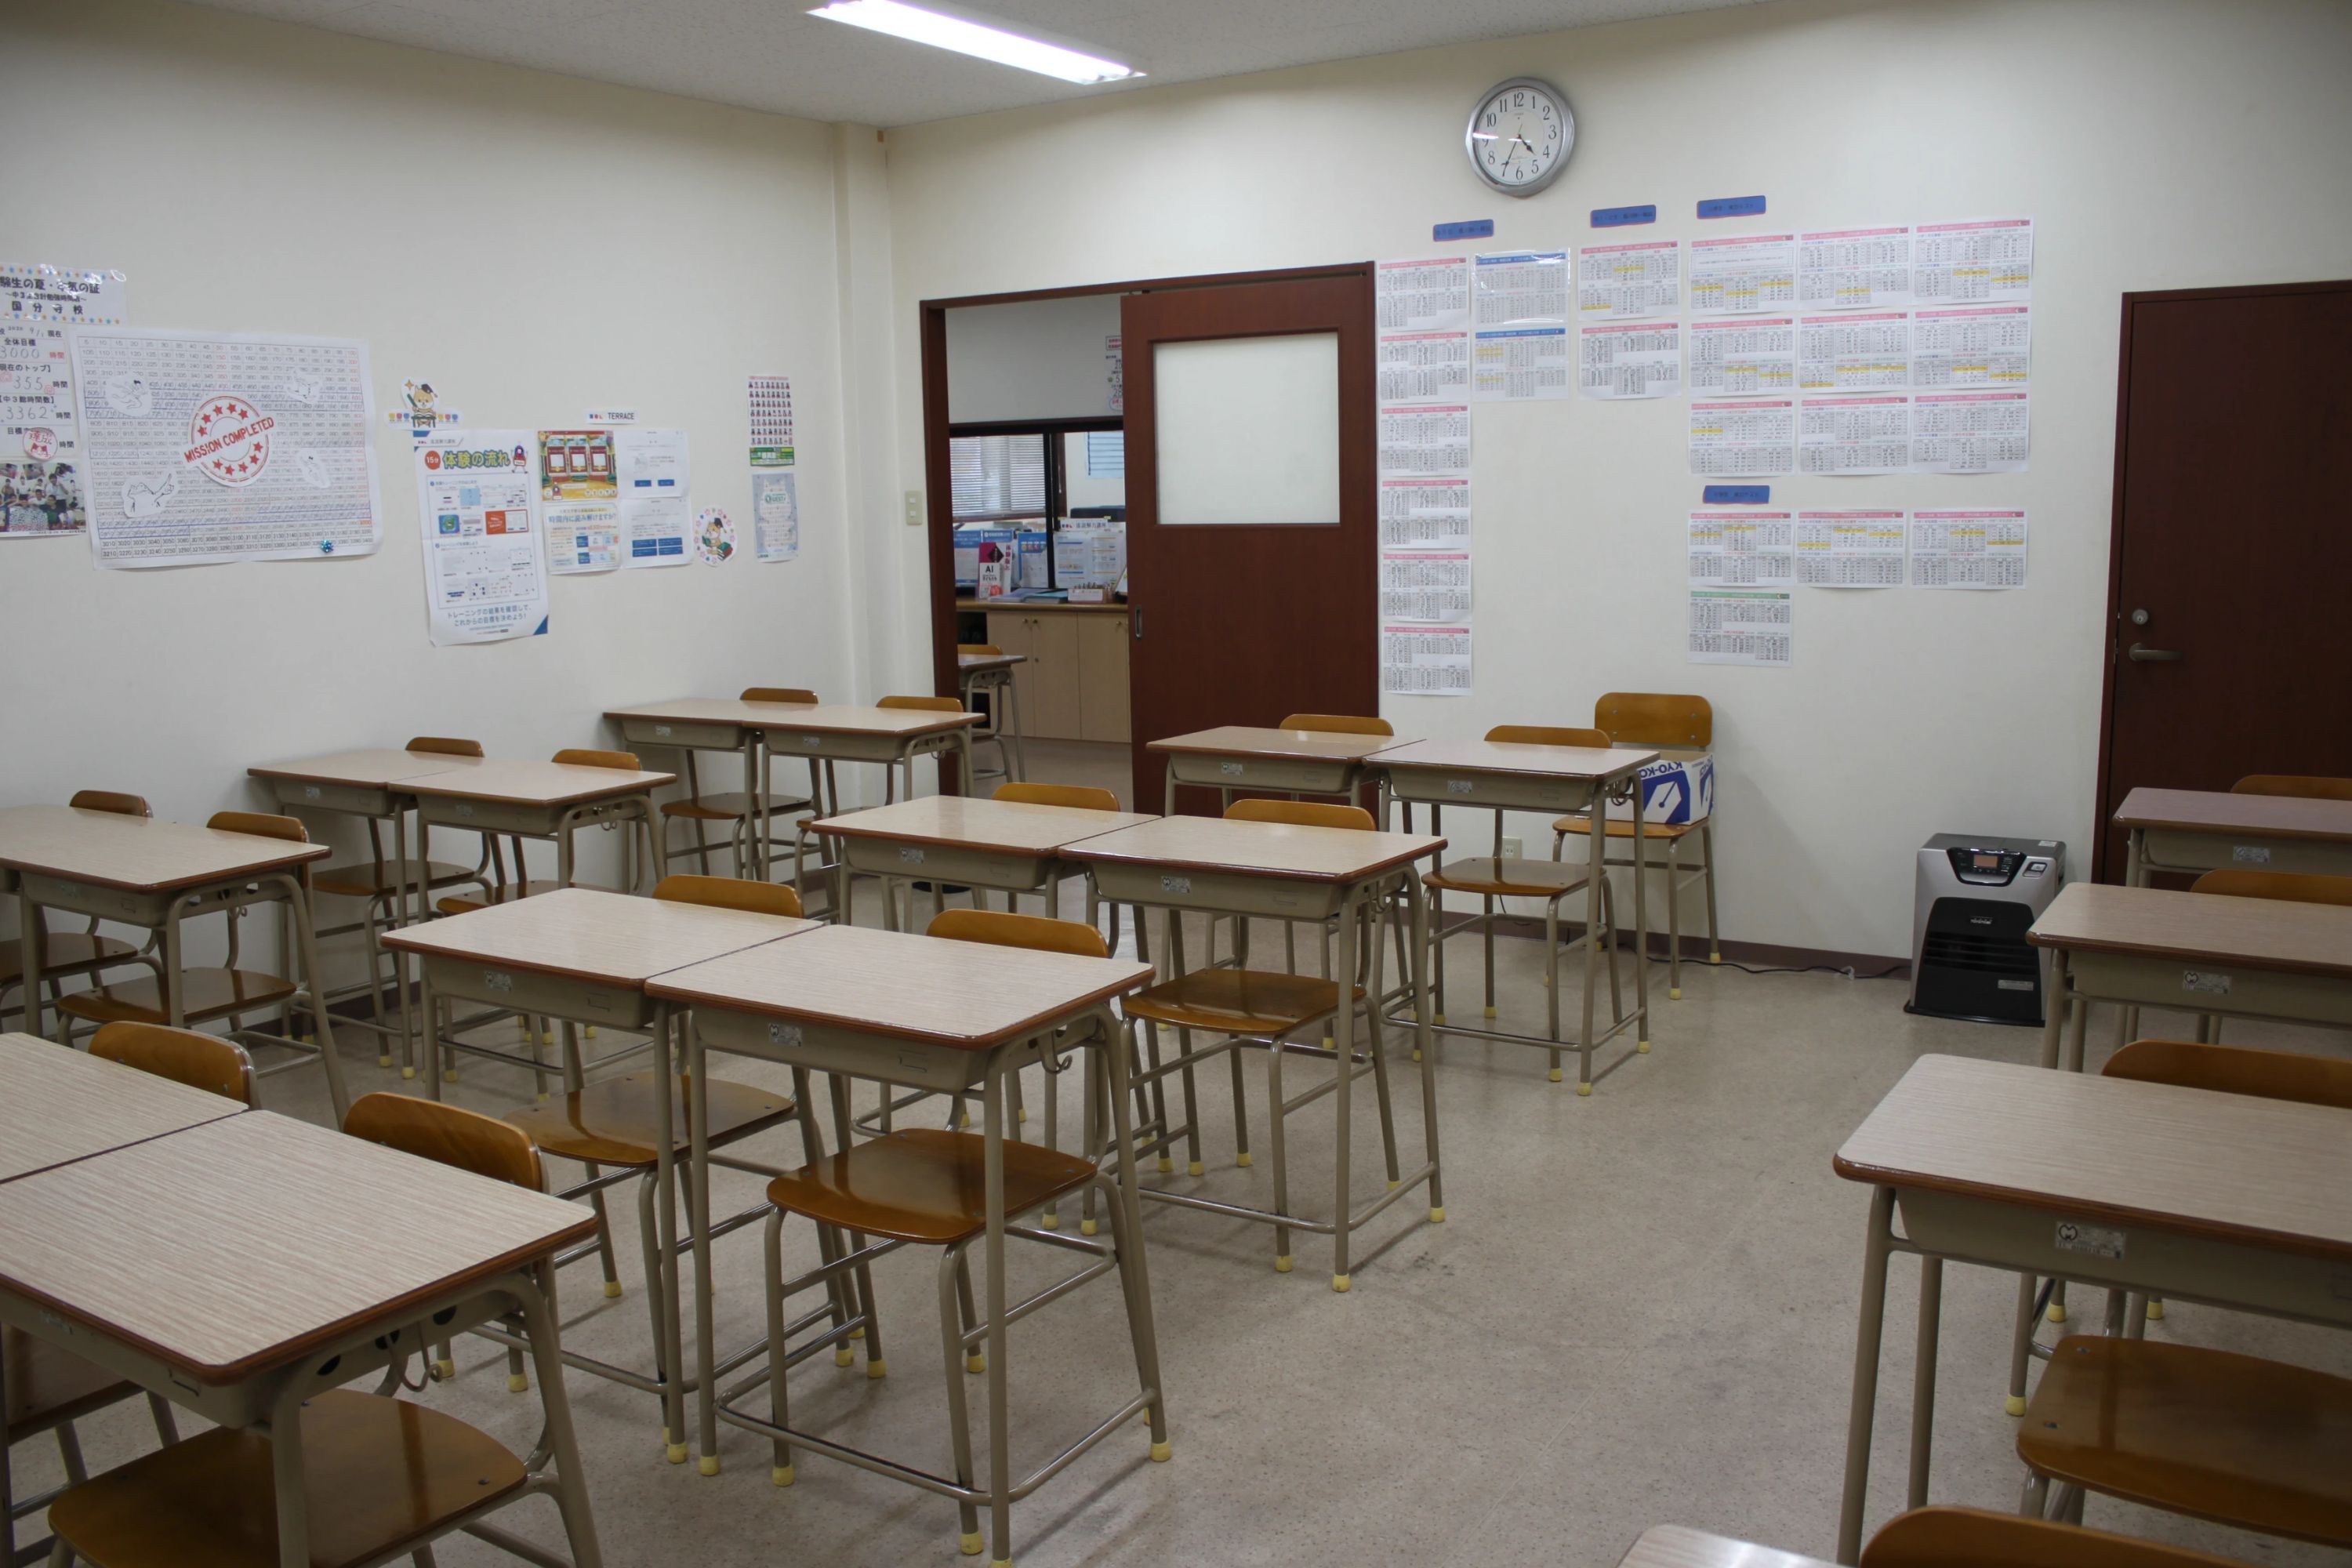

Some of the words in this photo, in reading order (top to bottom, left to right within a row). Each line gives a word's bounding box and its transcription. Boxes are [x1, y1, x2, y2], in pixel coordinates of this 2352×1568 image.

[1500, 99, 1508, 113] 11
[1514, 93, 1524, 107] 12
[1532, 96, 1536, 109] 1
[1486, 113, 1497, 127] 10
[1543, 106, 1550, 120] 2
[1548, 125, 1557, 140] 3
[1488, 151, 1495, 165] 8
[1543, 145, 1550, 158] 4
[1501, 162, 1509, 176] 7
[1516, 166, 1523, 180] 6
[1531, 160, 1539, 174] 5
[5, 337, 36, 346] 全体目標
[13, 376, 42, 390] 355
[6, 406, 48, 420] 3362
[184, 438, 223, 463] MISSION
[222, 416, 274, 448] COMPLETED
[442, 449, 511, 469] 体験の流れ
